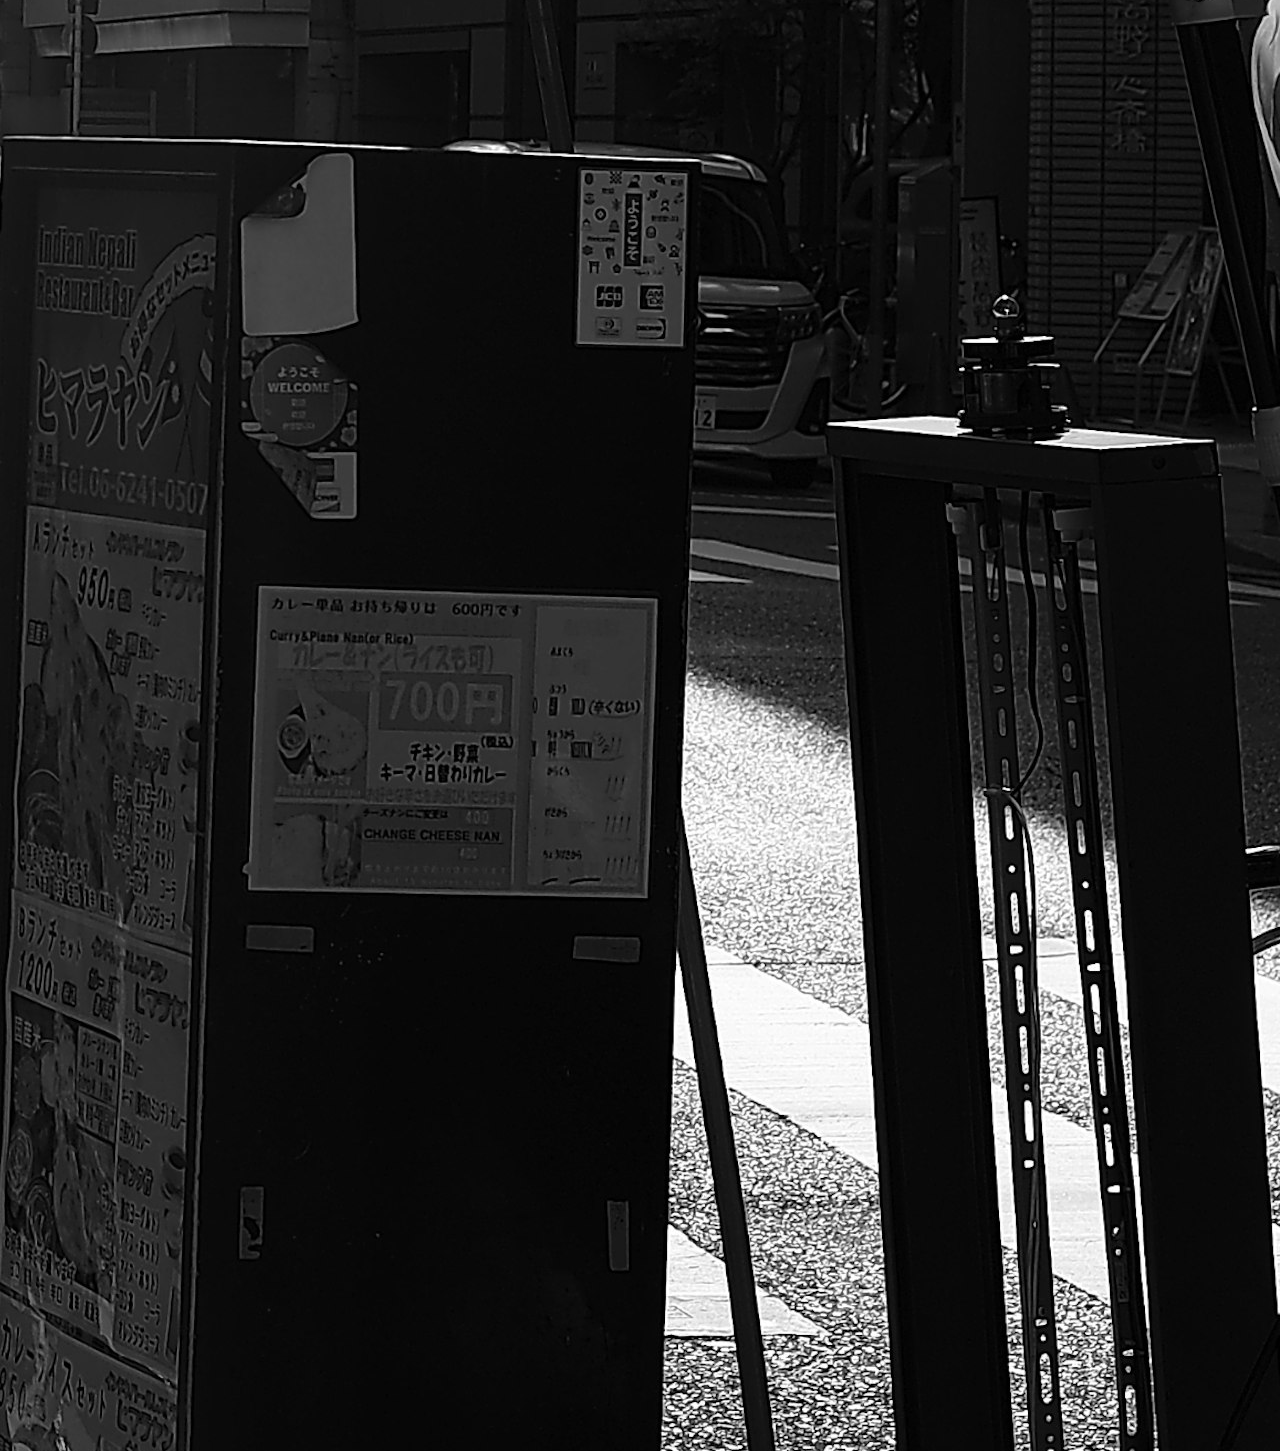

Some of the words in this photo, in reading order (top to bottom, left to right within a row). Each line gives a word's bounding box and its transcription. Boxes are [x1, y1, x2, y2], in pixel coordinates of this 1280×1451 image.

[626, 199, 640, 262] ようこそ
[39, 225, 84, 268] Indian
[88, 227, 137, 272] Nepali
[278, 366, 321, 379] ようこそ
[267, 382, 330, 394] WELCOME
[37, 358, 171, 451] ヒマラヤン
[272, 597, 344, 613] カレー単品
[349, 599, 437, 615] お持ち帰りは
[452, 602, 522, 617] 600円です
[384, 632, 414, 645] Rice)
[386, 680, 504, 726] 700円
[409, 743, 480, 763] チキン・野菜
[379, 763, 507, 783] キーマ・日替わりカレー
[363, 828, 416, 841] CHANGE
[420, 829, 470, 842] CHEESE
[474, 831, 501, 843] NAN
